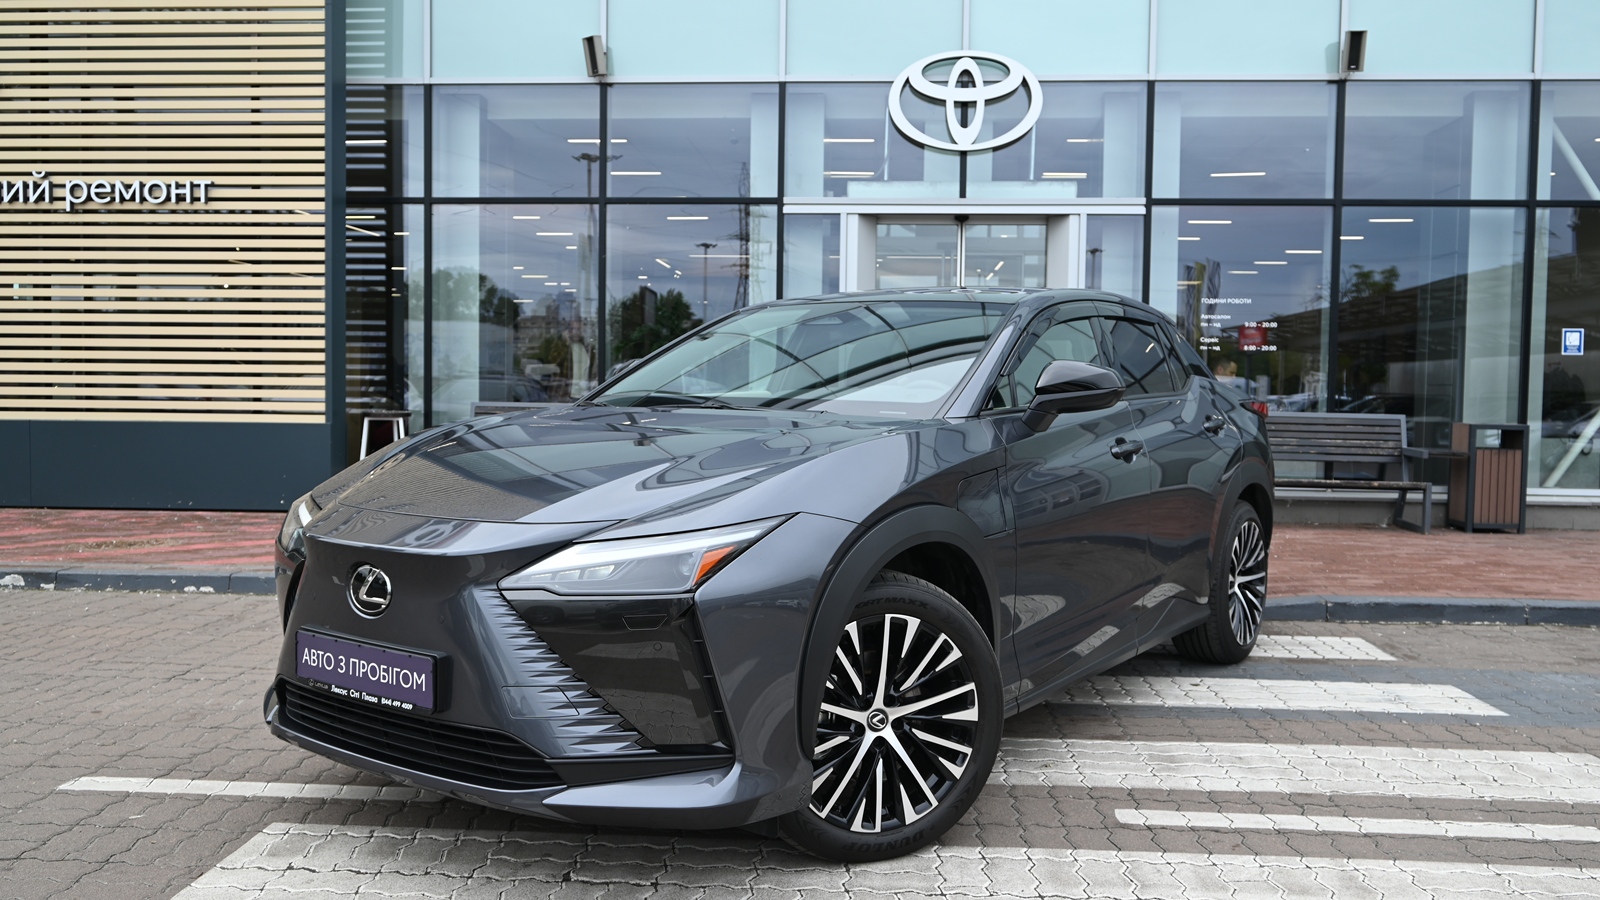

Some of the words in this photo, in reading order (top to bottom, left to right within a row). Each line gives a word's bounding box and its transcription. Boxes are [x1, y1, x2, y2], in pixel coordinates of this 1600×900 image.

[1, 171, 50, 204] ий
[65, 179, 212, 212] ремонт
[1201, 297, 1227, 305] ГОДИНИ
[855, 597, 884, 609] ORT
[302, 647, 335, 671] АВТО
[337, 655, 346, 674] З
[349, 658, 426, 692] ПРОБІГОМ
[330, 684, 348, 696] Лексус
[841, 828, 925, 854] DUNLOP
